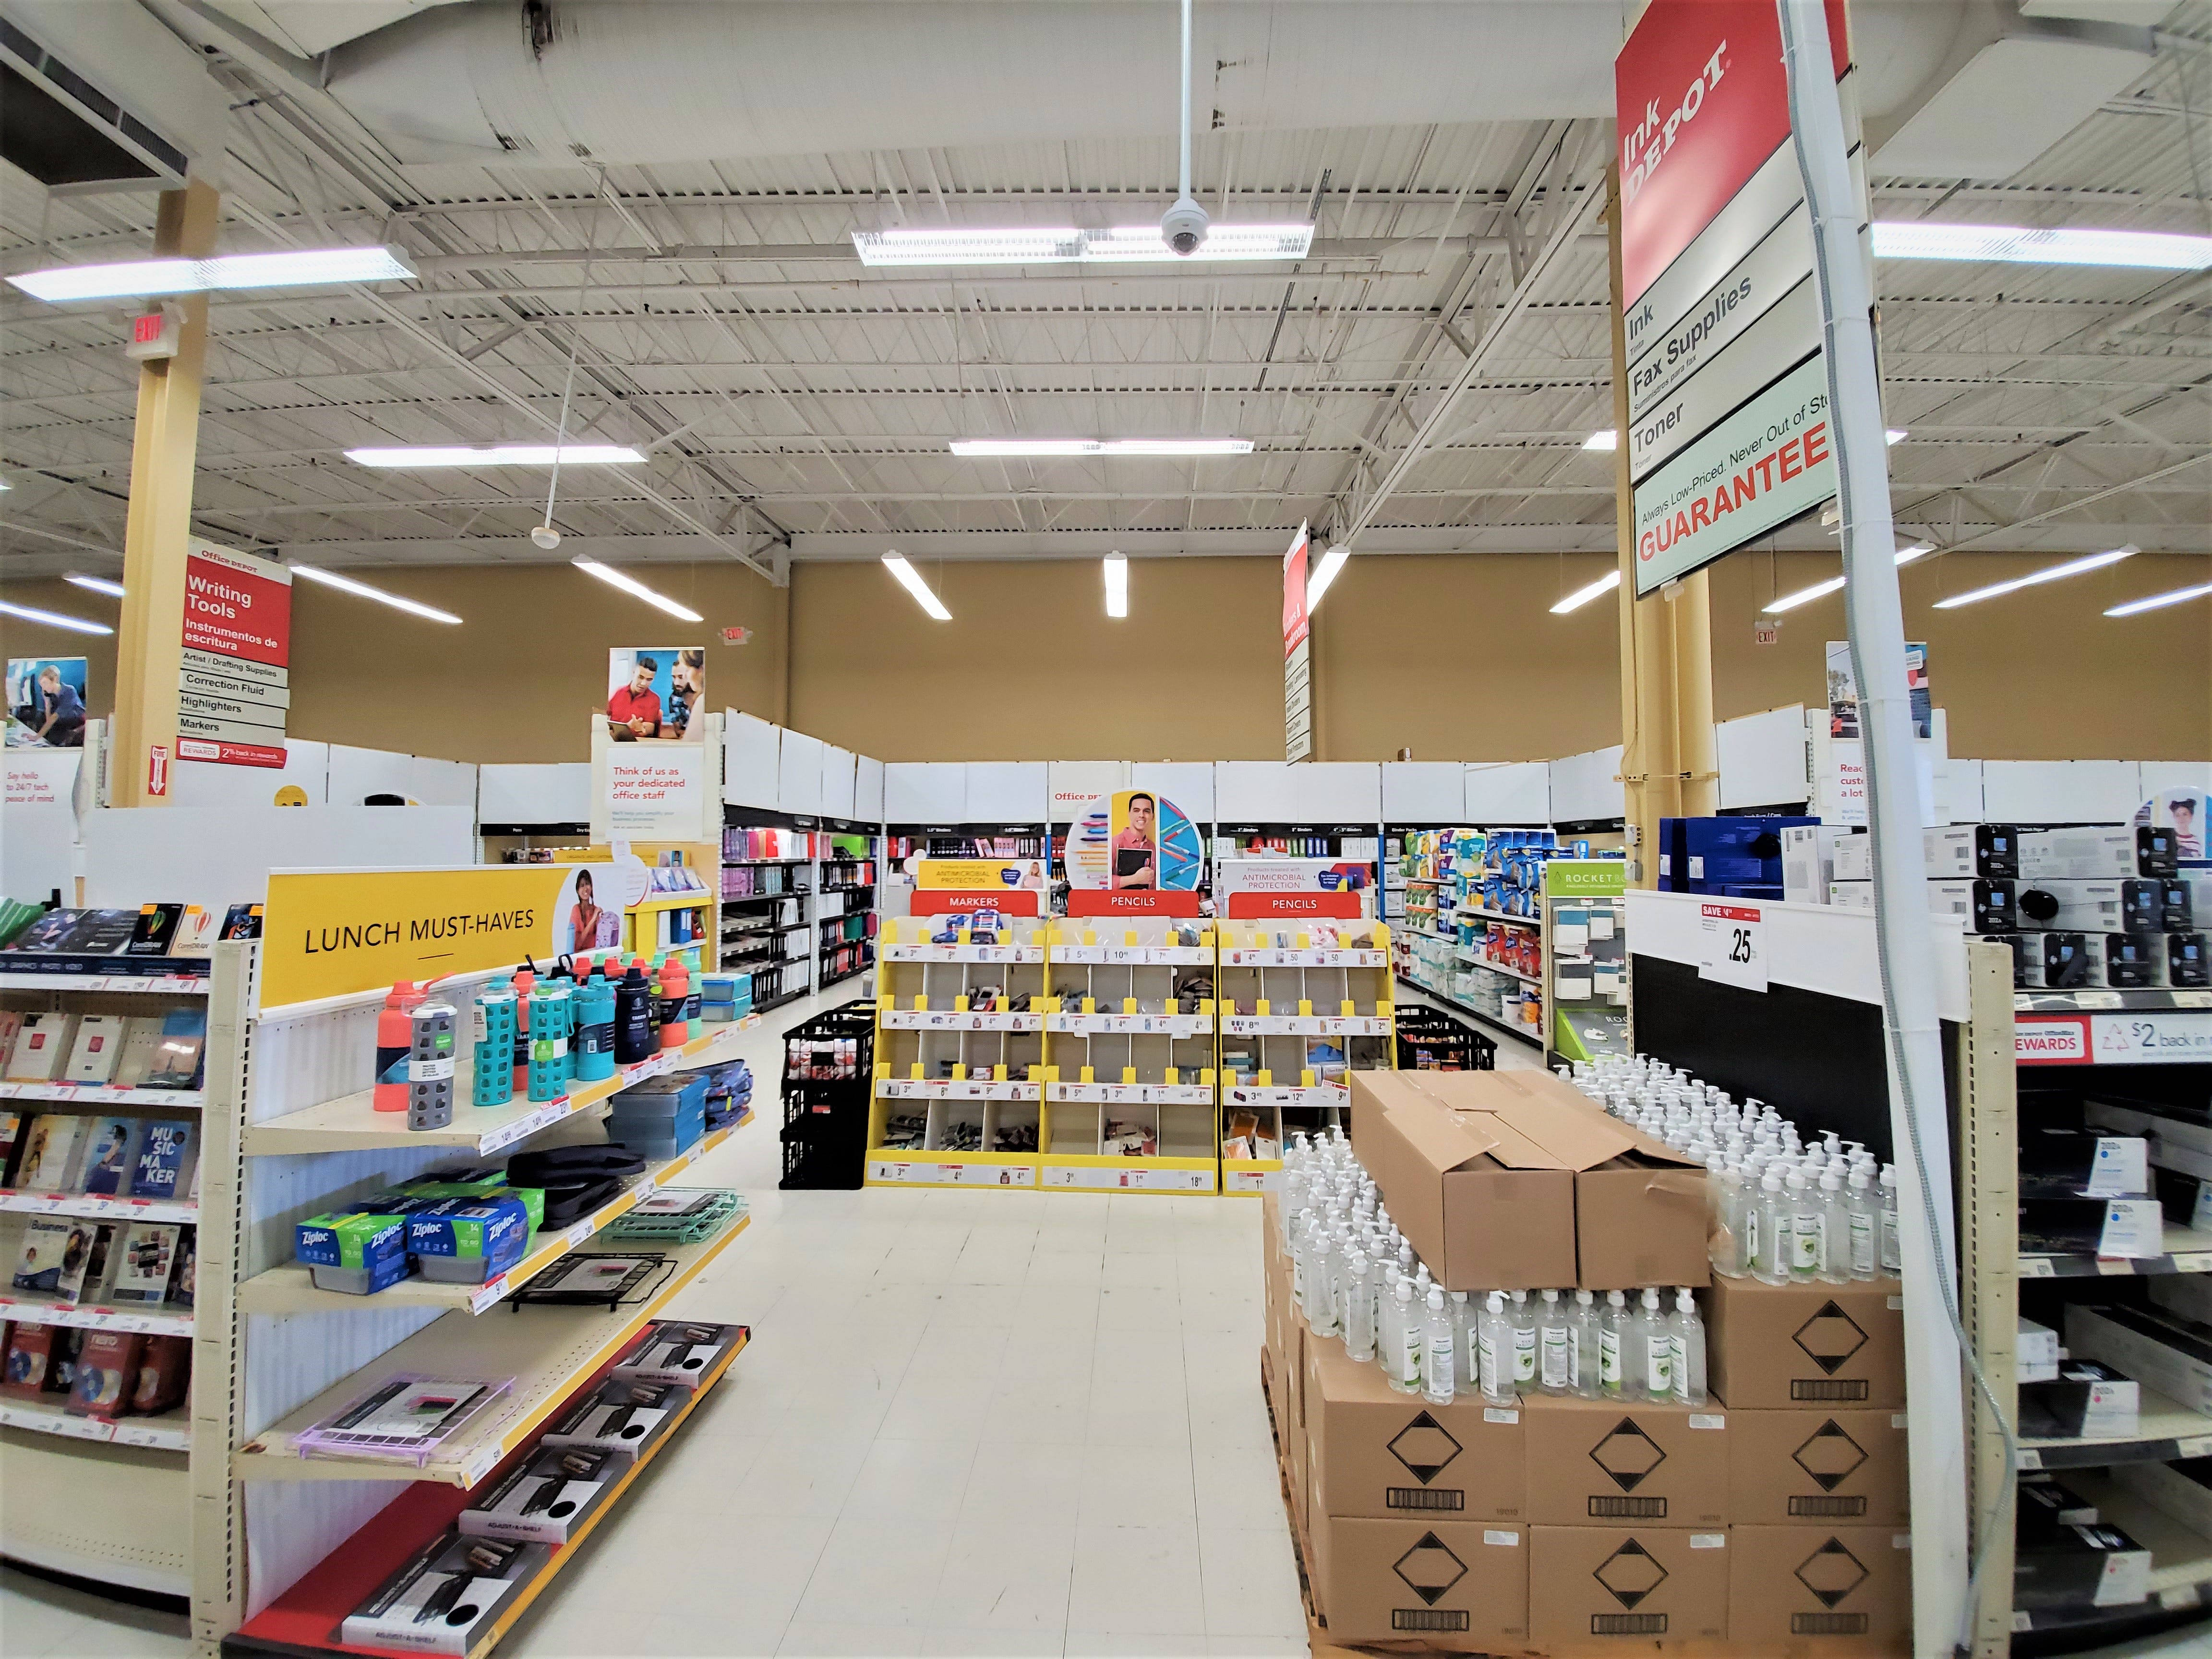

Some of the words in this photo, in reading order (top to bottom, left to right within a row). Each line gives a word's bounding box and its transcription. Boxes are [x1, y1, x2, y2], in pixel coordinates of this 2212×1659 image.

[1625, 38, 1727, 208] DEPOT
[1624, 96, 1660, 172] Ink
[1630, 304, 1653, 341] Ink
[1634, 358, 1662, 397] Fax
[1667, 276, 1751, 365] Supplies
[1634, 379, 1669, 412] Suministros
[1671, 364, 1684, 384] para
[1686, 354, 1697, 371] fax
[1634, 403, 1684, 453] Toner
[1635, 454, 1652, 471] Toner
[1642, 499, 1669, 526] Always
[1671, 460, 1727, 506] Low-Priced.
[1730, 437, 1763, 467] Never
[1767, 419, 1790, 442] Out
[1793, 405, 1806, 425] of
[1640, 421, 1829, 562] GUARANTEE
[202, 550, 230, 565] Office
[231, 561, 258, 573] DEPOT
[188, 575, 252, 608] Writing
[188, 593, 236, 619] Tools
[185, 633, 238, 651] escritura
[186, 618, 262, 645] Instrumentos
[265, 637, 278, 649] de
[1758, 631, 1775, 642] EXIT
[183, 653, 206, 663] Artist
[213, 659, 243, 672] Drafting
[245, 665, 277, 678] Supplies
[186, 673, 239, 691] Correction
[241, 684, 264, 696] Fluid
[181, 696, 242, 713] Highlighters
[180, 719, 219, 732] Markers
[183, 747, 216, 756] REWARDS
[613, 767, 639, 775] Think
[642, 767, 653, 775] of
[613, 781, 635, 789] your
[638, 779, 685, 788] dedicated
[613, 791, 639, 799] office
[643, 791, 665, 799] staff
[1850, 789, 1863, 797] lot
[950, 897, 999, 906] MARKERS
[1111, 897, 1155, 907] PENCILS
[1272, 900, 1317, 909] PENCILS
[1703, 906, 1721, 916] SAVE
[305, 921, 400, 953] LUNCH
[410, 909, 534, 941] MUST-HAVES
[1729, 928, 1751, 963] .25
[2160, 1033, 2192, 1047] back
[2194, 1034, 2205, 1046] in
[150, 1127, 173, 1142] MU
[152, 1141, 176, 1156] SIC
[139, 1154, 160, 1168] MA
[146, 1169, 176, 1184] KER
[371, 1221, 403, 1249] Ziploc
[412, 1223, 442, 1238] Ziploc
[489, 1212, 517, 1243] Ziploc
[301, 1230, 329, 1245] Ziploc
